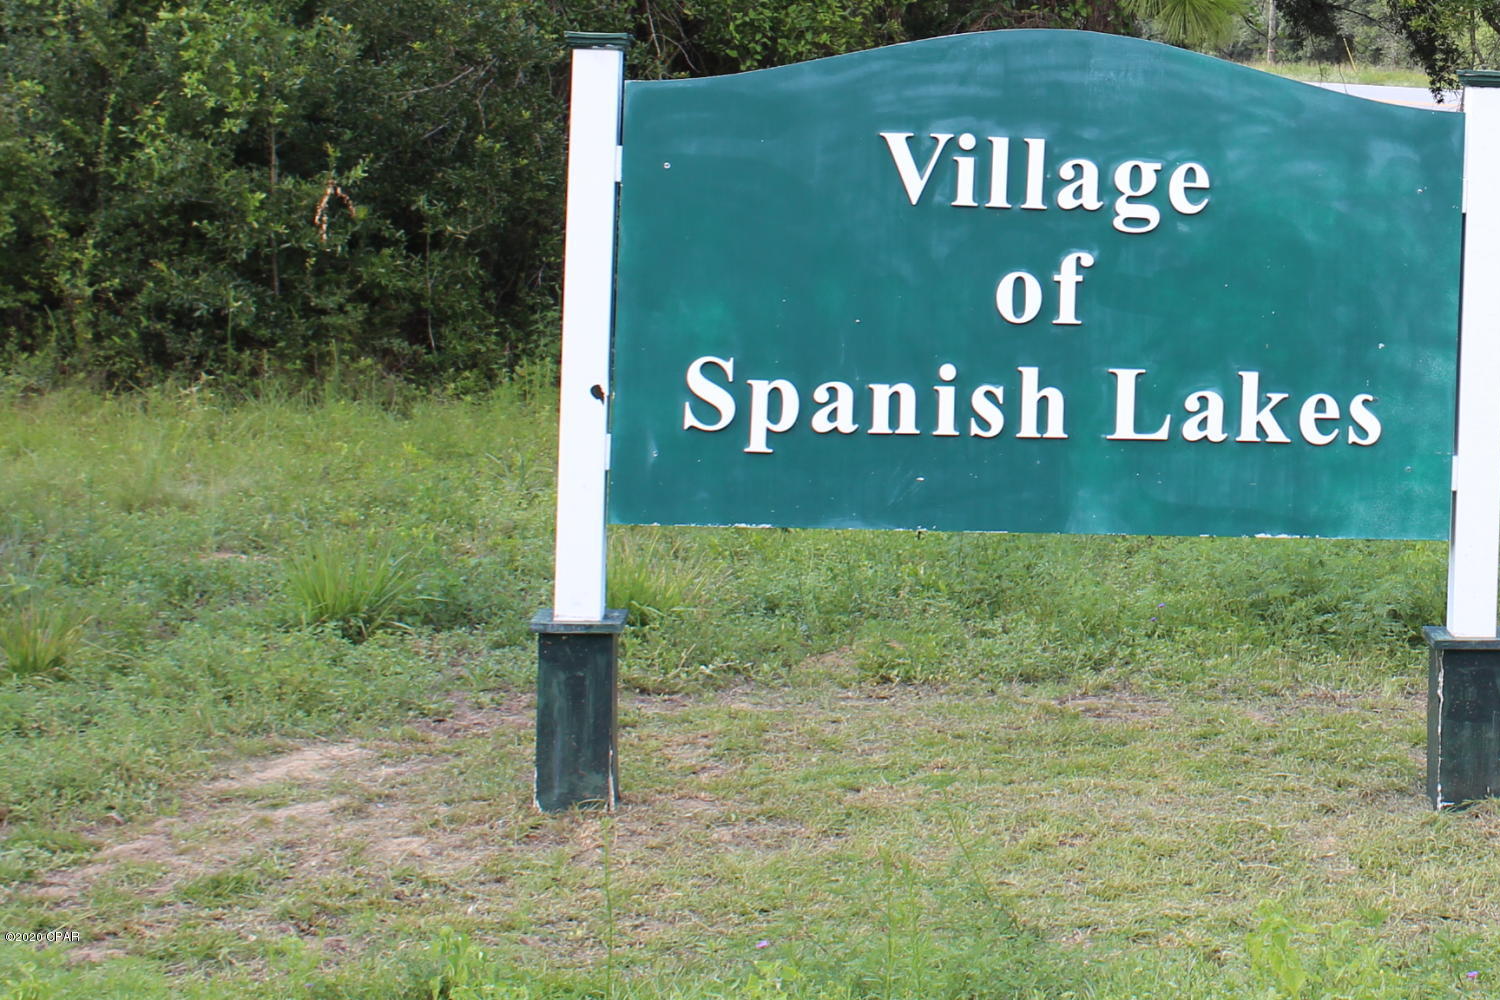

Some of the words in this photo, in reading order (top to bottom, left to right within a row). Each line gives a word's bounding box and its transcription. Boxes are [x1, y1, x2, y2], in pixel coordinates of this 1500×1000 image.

[878, 131, 1211, 234] Village
[995, 250, 1096, 325] of
[682, 355, 1069, 454] Spanish
[1105, 367, 1383, 447] Lakes
